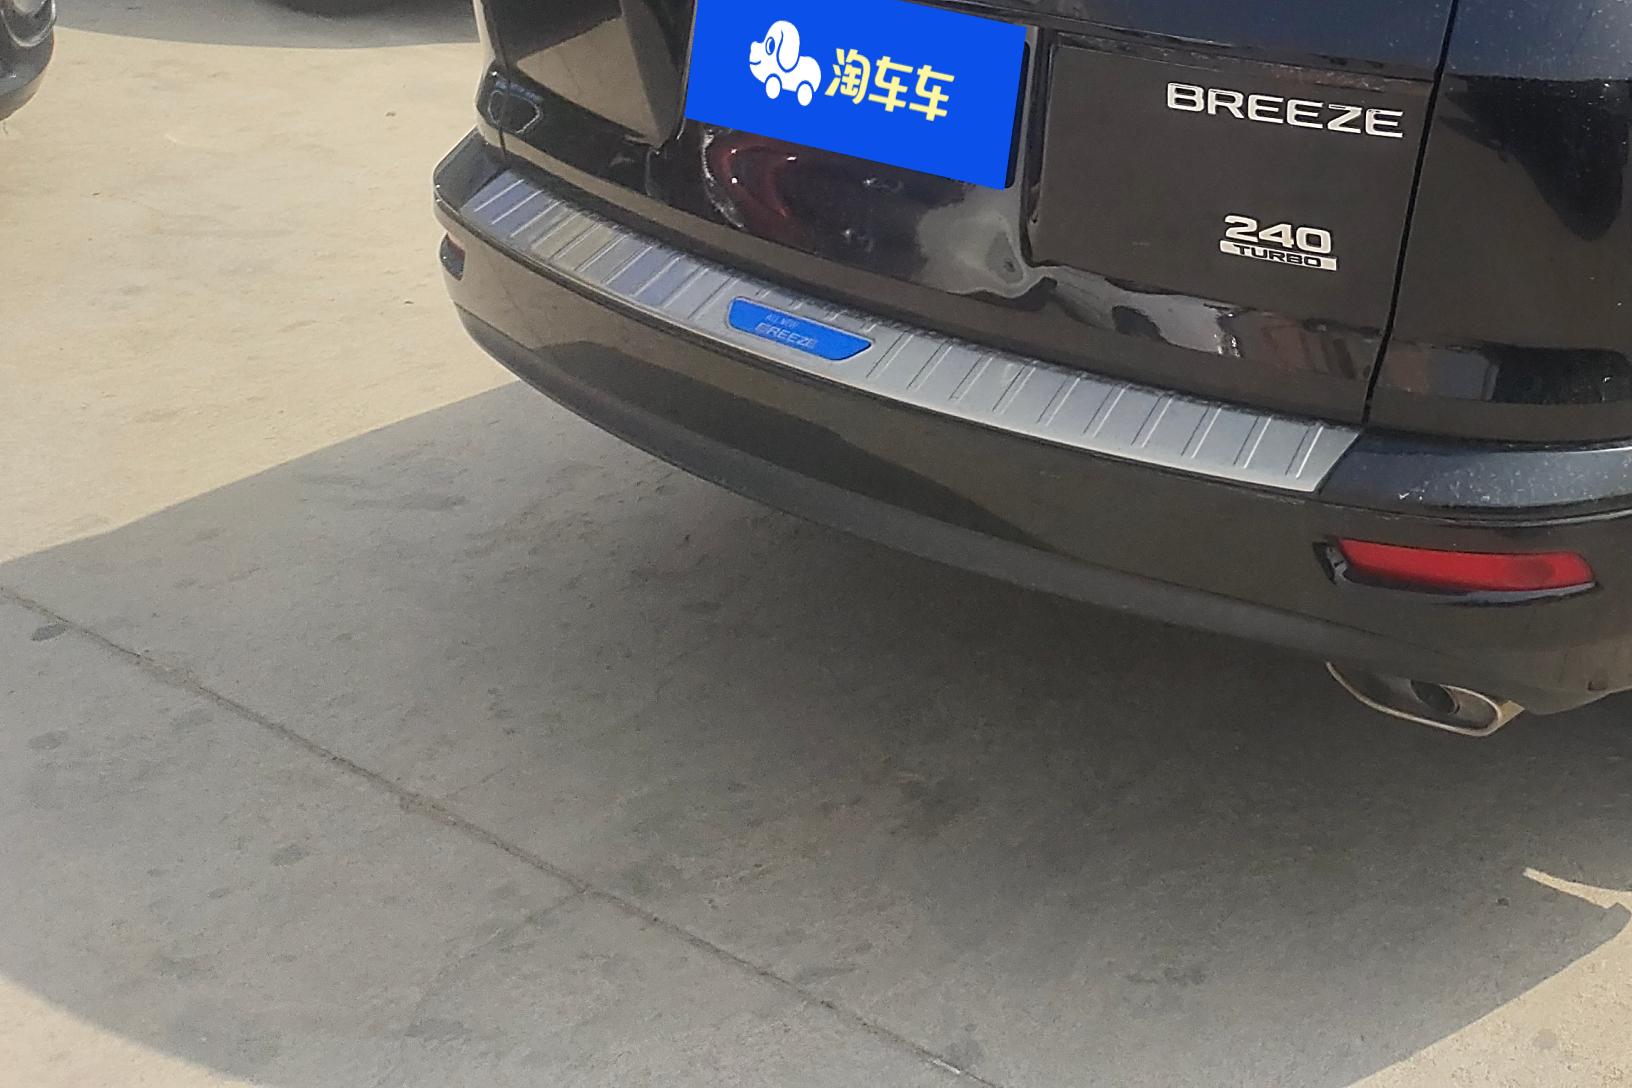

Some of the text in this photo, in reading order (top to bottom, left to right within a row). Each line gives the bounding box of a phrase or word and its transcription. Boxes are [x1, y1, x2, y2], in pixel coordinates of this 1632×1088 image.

[1166, 81, 1404, 139] BREEZE
[1223, 214, 1332, 255] 240
[1234, 243, 1323, 268] TURBO
